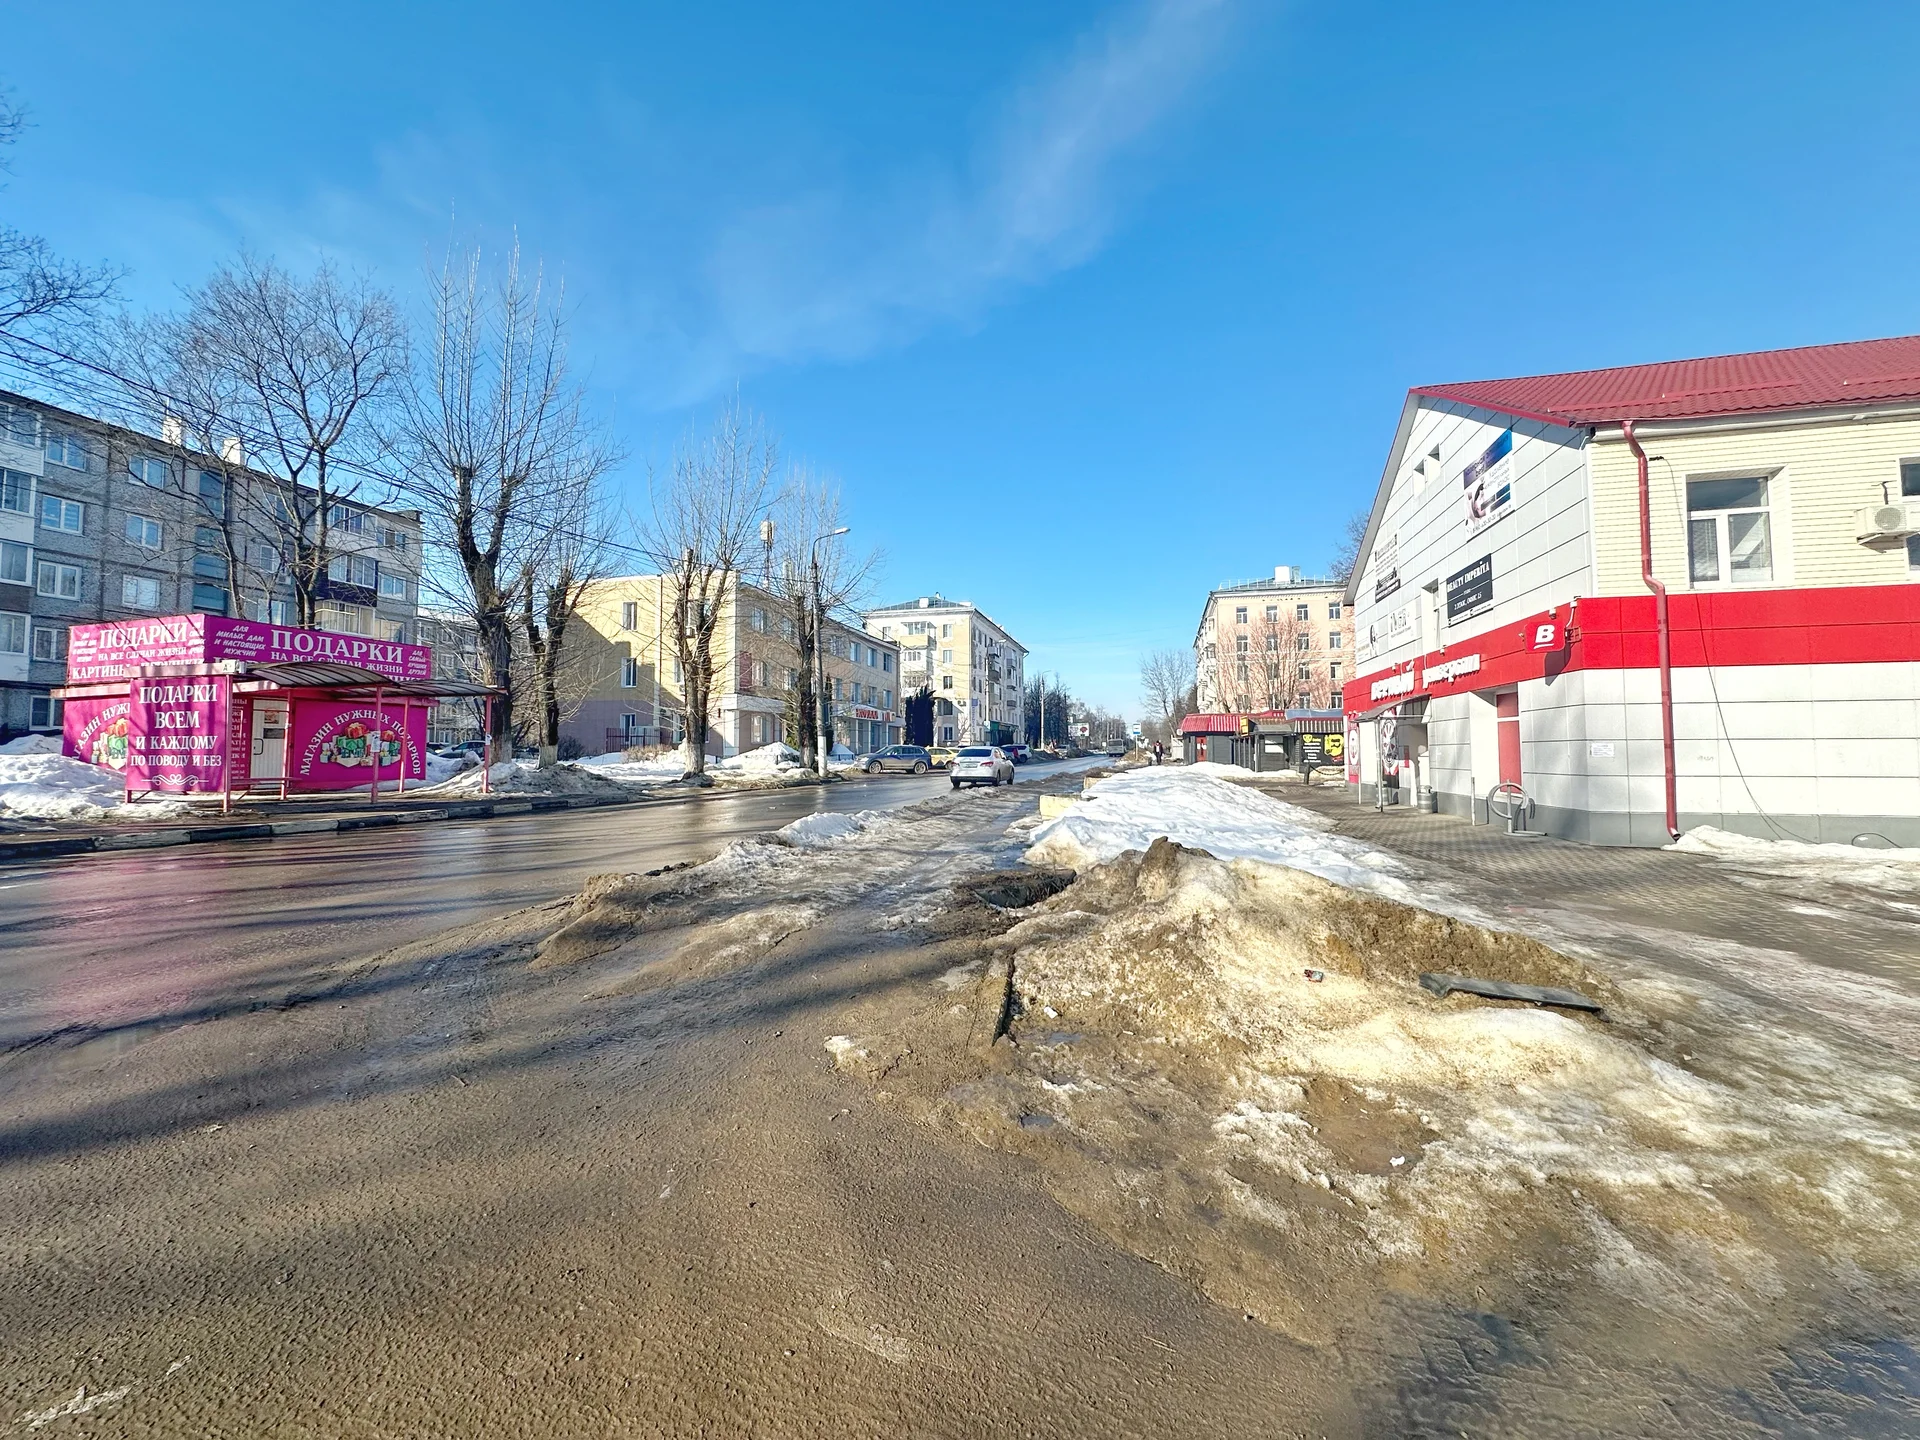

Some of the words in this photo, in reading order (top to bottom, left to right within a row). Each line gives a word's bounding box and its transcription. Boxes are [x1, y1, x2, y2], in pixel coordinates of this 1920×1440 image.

[98, 622, 189, 650] ПОДАРКИ
[216, 630, 245, 640] МИЛЫХ
[247, 634, 265, 642] ДАМ
[233, 625, 249, 633] ДЛЯ
[223, 639, 266, 650] НАСТОЯЩИХ
[223, 647, 257, 657] МУЖЧИН
[270, 629, 404, 664] ПОДАРКИ
[110, 652, 124, 660] ВСЕ
[271, 651, 288, 662] НА
[292, 654, 314, 662] ВСЕ
[366, 662, 403, 674] ЖИЗНИ
[139, 684, 218, 706] ПОДАРКИ
[155, 711, 200, 729] ВСЕМ
[73, 716, 101, 759] ГАЗИН
[135, 736, 146, 750] И
[151, 735, 218, 751] КАЖДОМУ
[300, 722, 334, 776] МАГАЗИН
[334, 709, 391, 726] НУЖНЫХ
[131, 755, 146, 766] ПО
[148, 755, 189, 767] ПОВОДУ
[192, 755, 200, 766] И
[203, 755, 222, 767] БЕЗ
